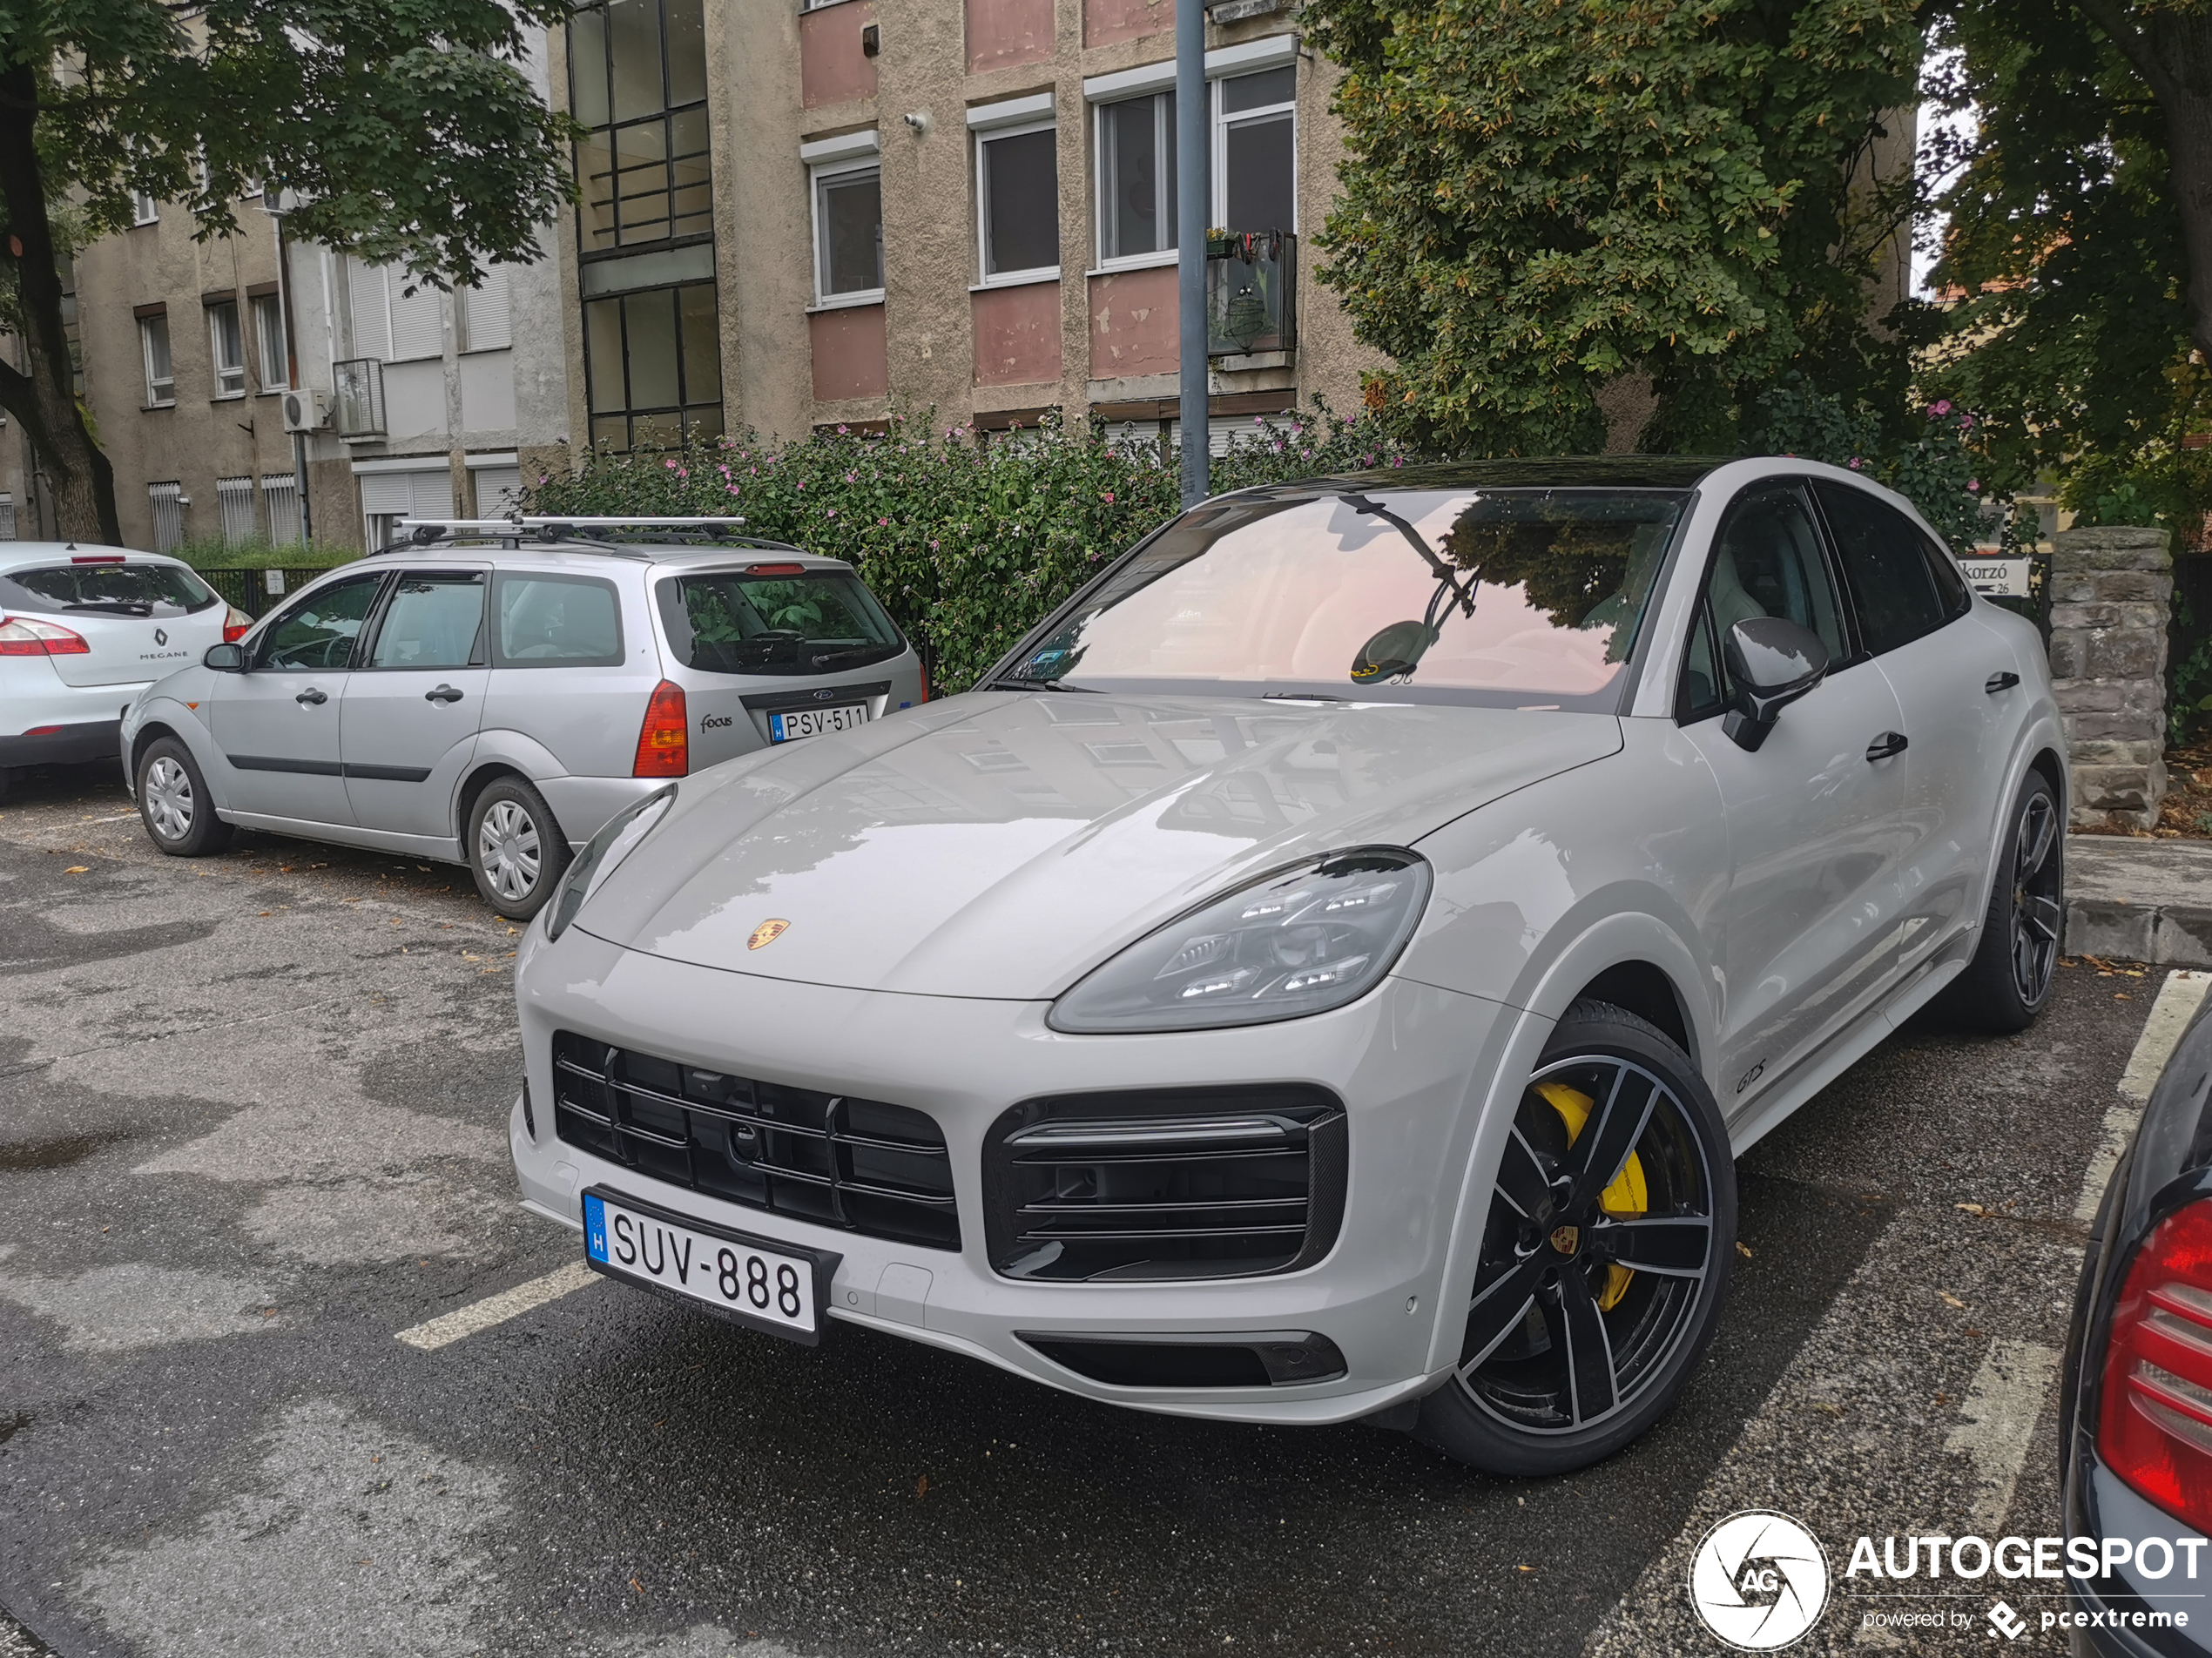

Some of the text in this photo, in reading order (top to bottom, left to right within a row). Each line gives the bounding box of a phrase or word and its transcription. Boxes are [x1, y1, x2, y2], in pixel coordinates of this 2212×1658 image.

[1962, 563, 2007, 580] korzó
[1997, 583, 2010, 594] 26
[700, 713, 732, 734] focus
[775, 707, 863, 738] H PSV-511
[1737, 1057, 1766, 1094] GTS
[593, 1211, 801, 1318] H SUV-888
